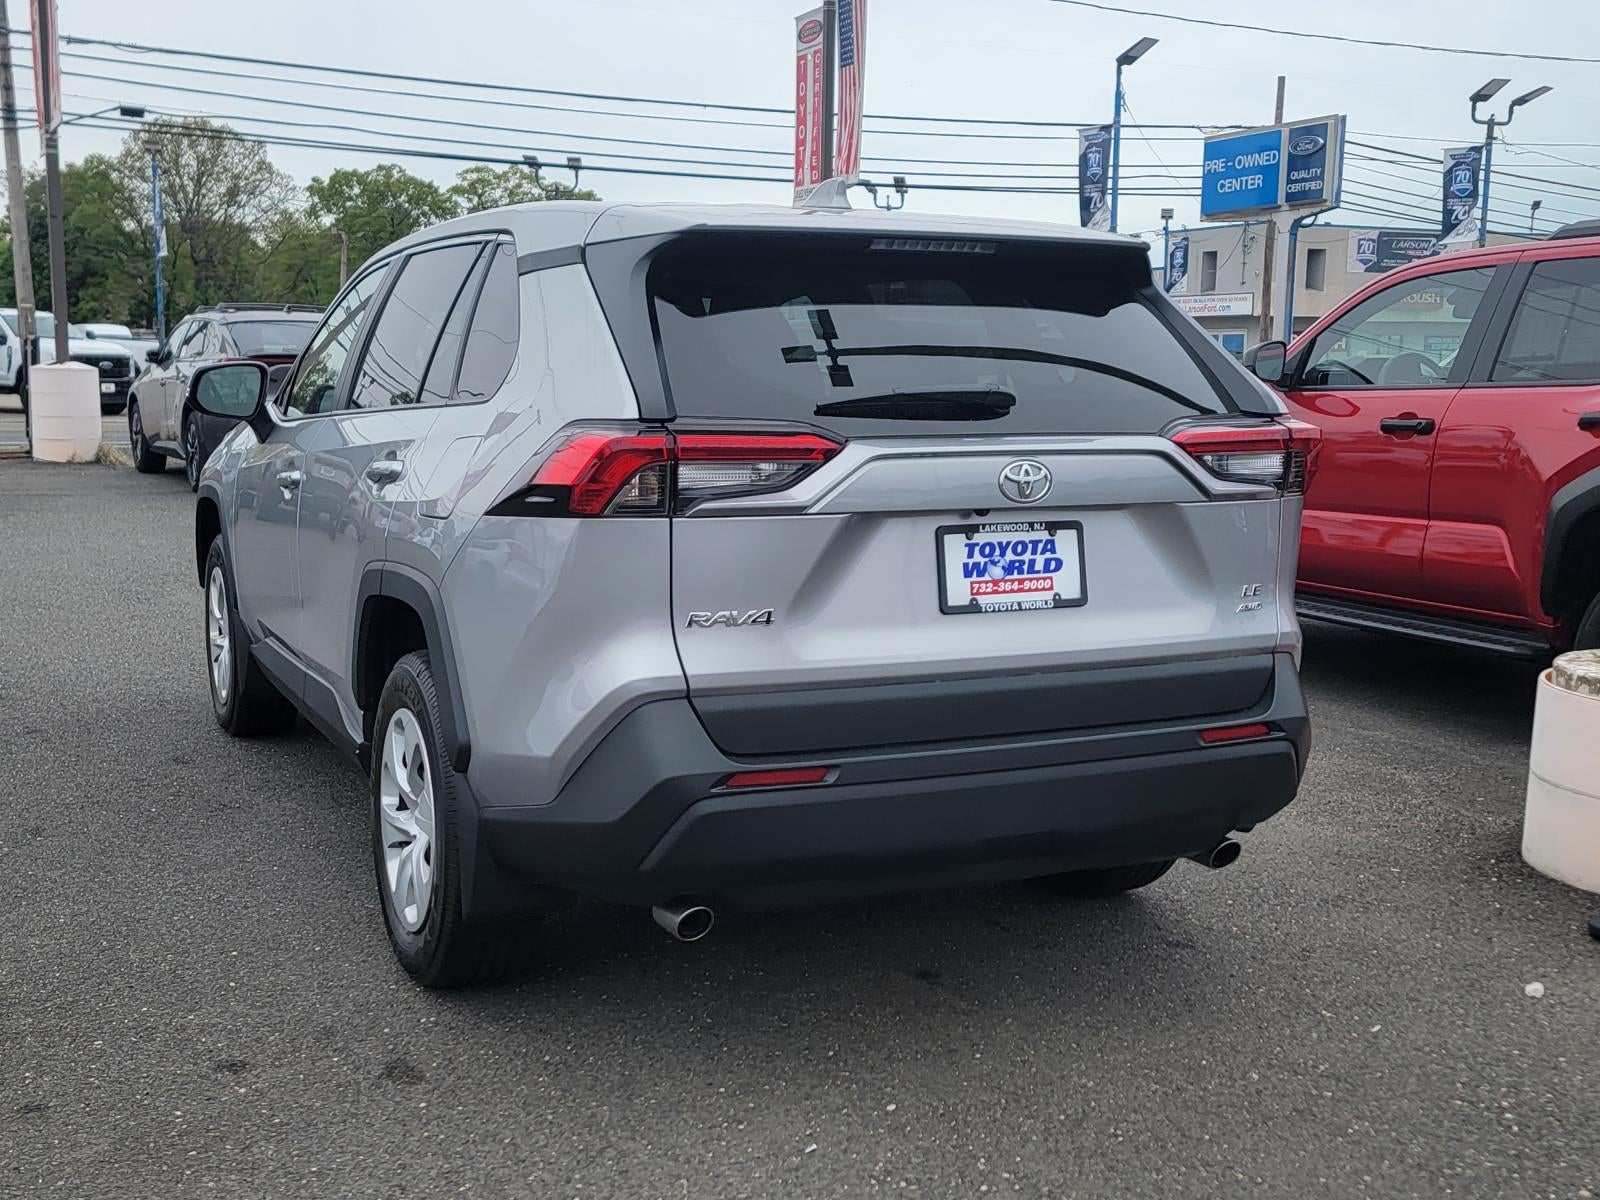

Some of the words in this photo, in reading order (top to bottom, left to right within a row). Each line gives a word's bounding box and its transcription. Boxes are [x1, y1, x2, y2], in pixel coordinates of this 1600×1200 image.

[797, 60, 806, 182] TOYOTA
[812, 53, 821, 180] CERTIFIED
[1290, 168, 1322, 180] QUALITY
[1217, 174, 1264, 193] CENTER
[1286, 180, 1323, 193] CERTIFIED
[1391, 240, 1429, 249] LARSON
[1184, 304, 1231, 313] LarsonFord.com
[979, 523, 1032, 533] LAKEWOOD,
[1034, 522, 1046, 530] NJ
[964, 538, 1057, 559] TOYOTA
[972, 579, 1052, 594] 732-364-9000
[1241, 584, 1262, 598] LE
[980, 602, 1019, 613] TOYOTA
[1021, 600, 1055, 610] WORLD
[684, 607, 776, 629] RAV4
